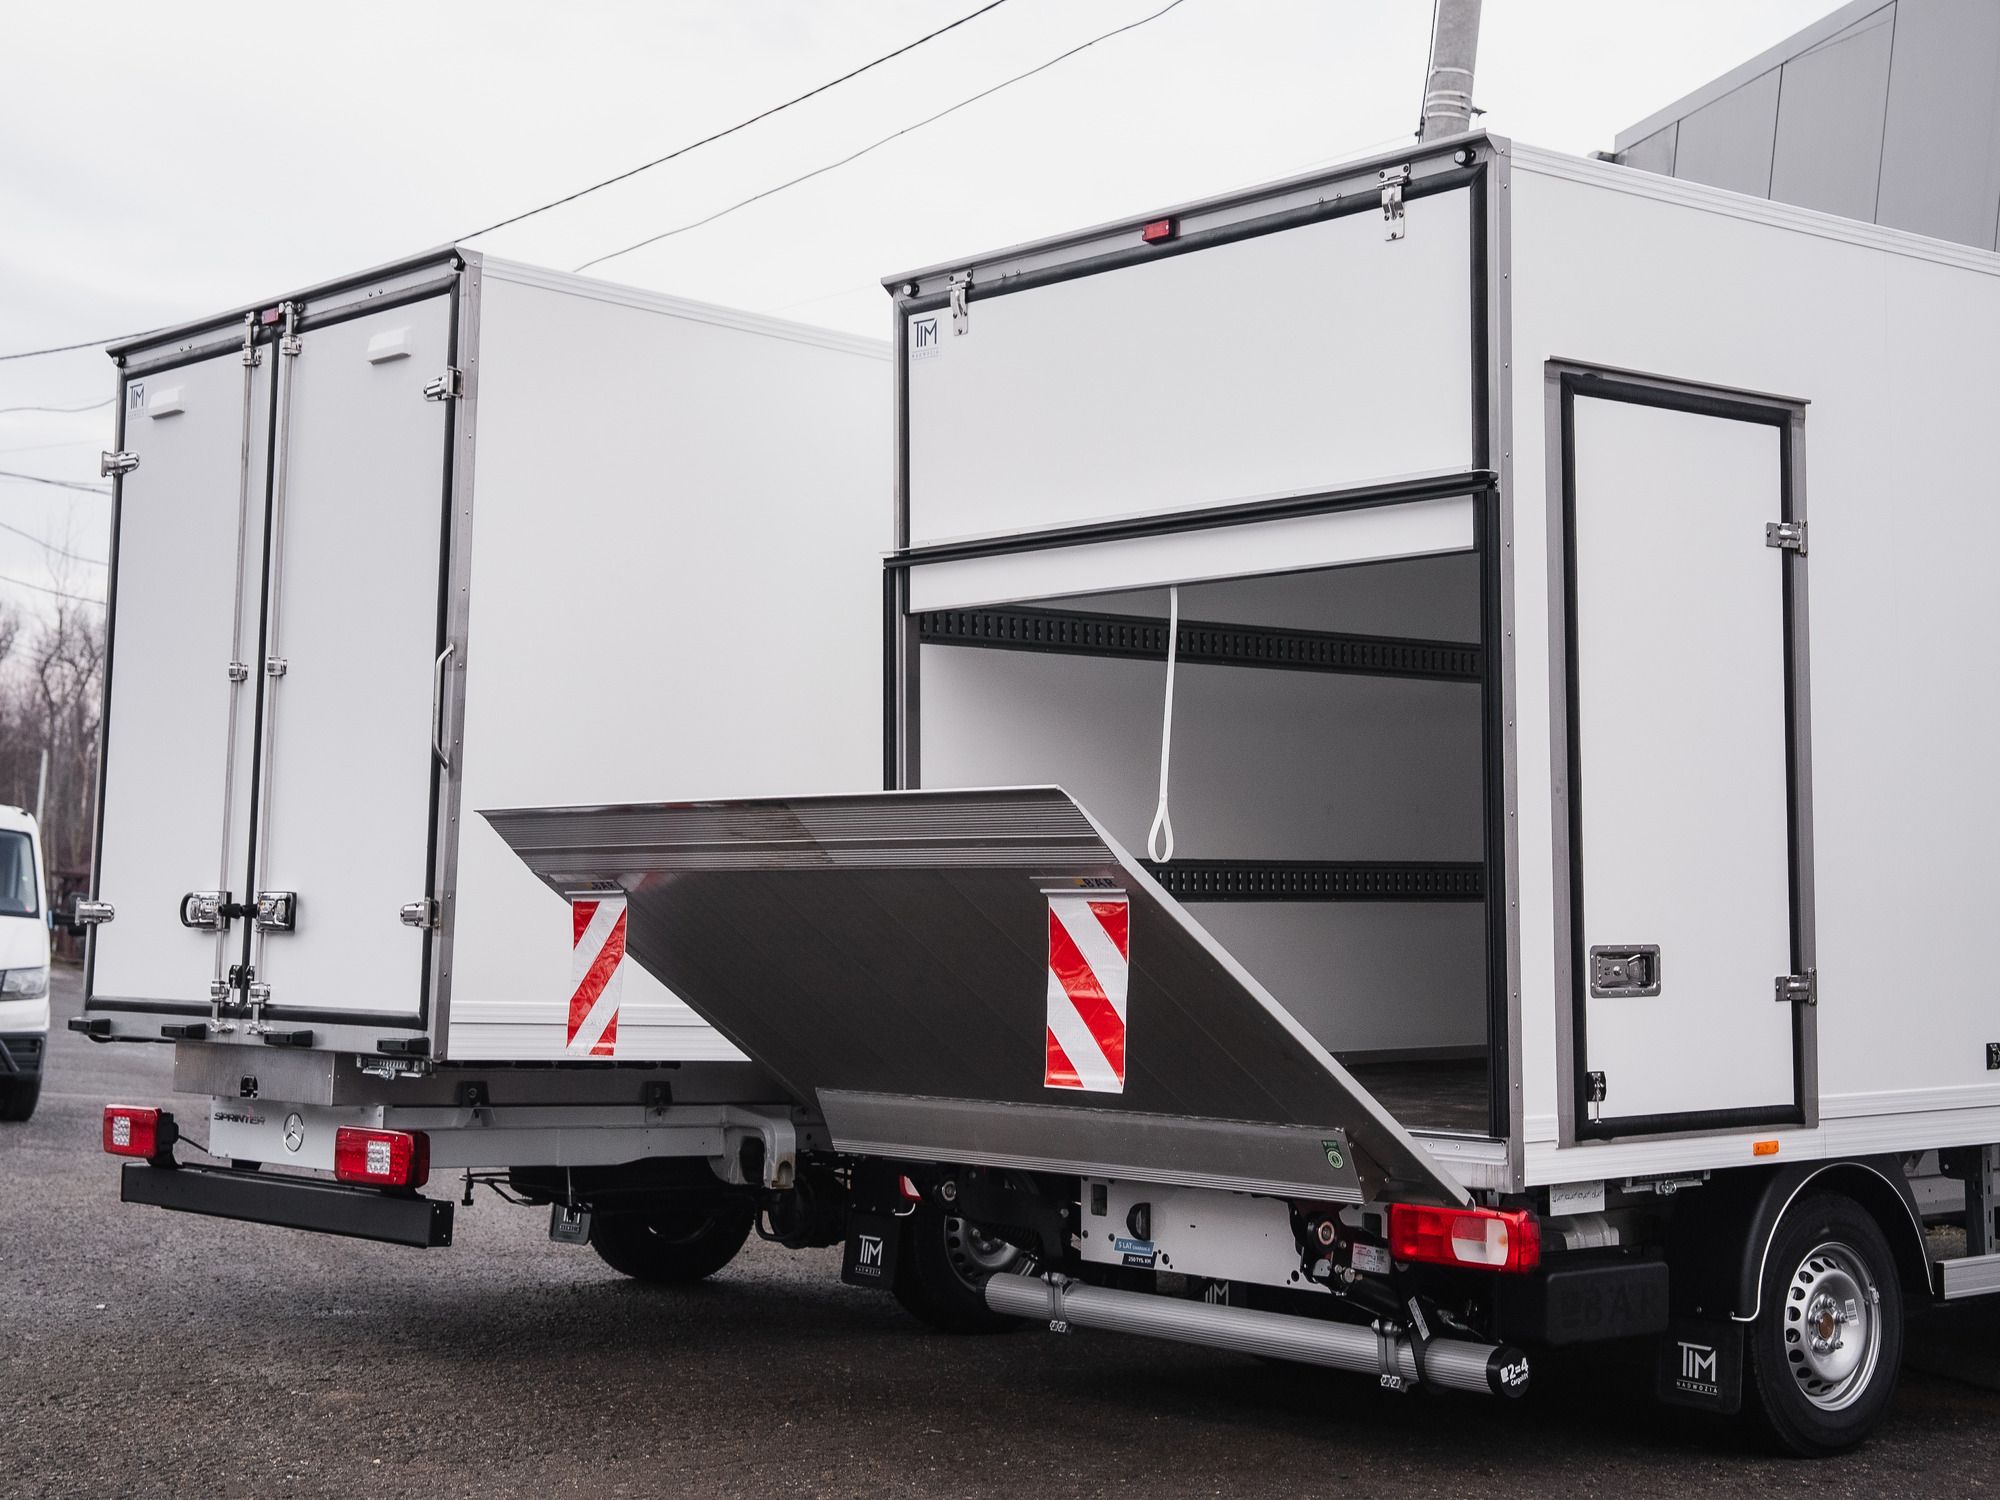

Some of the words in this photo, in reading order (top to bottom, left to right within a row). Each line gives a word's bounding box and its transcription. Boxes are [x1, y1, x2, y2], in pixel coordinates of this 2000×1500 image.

[913, 317, 937, 348] TIM
[130, 383, 144, 409] TIM
[213, 1112, 265, 1125] SPRINTER
[859, 1234, 883, 1266] TIM
[1122, 1242, 1132, 1250] LAT
[1677, 1341, 1716, 1382] TIM
